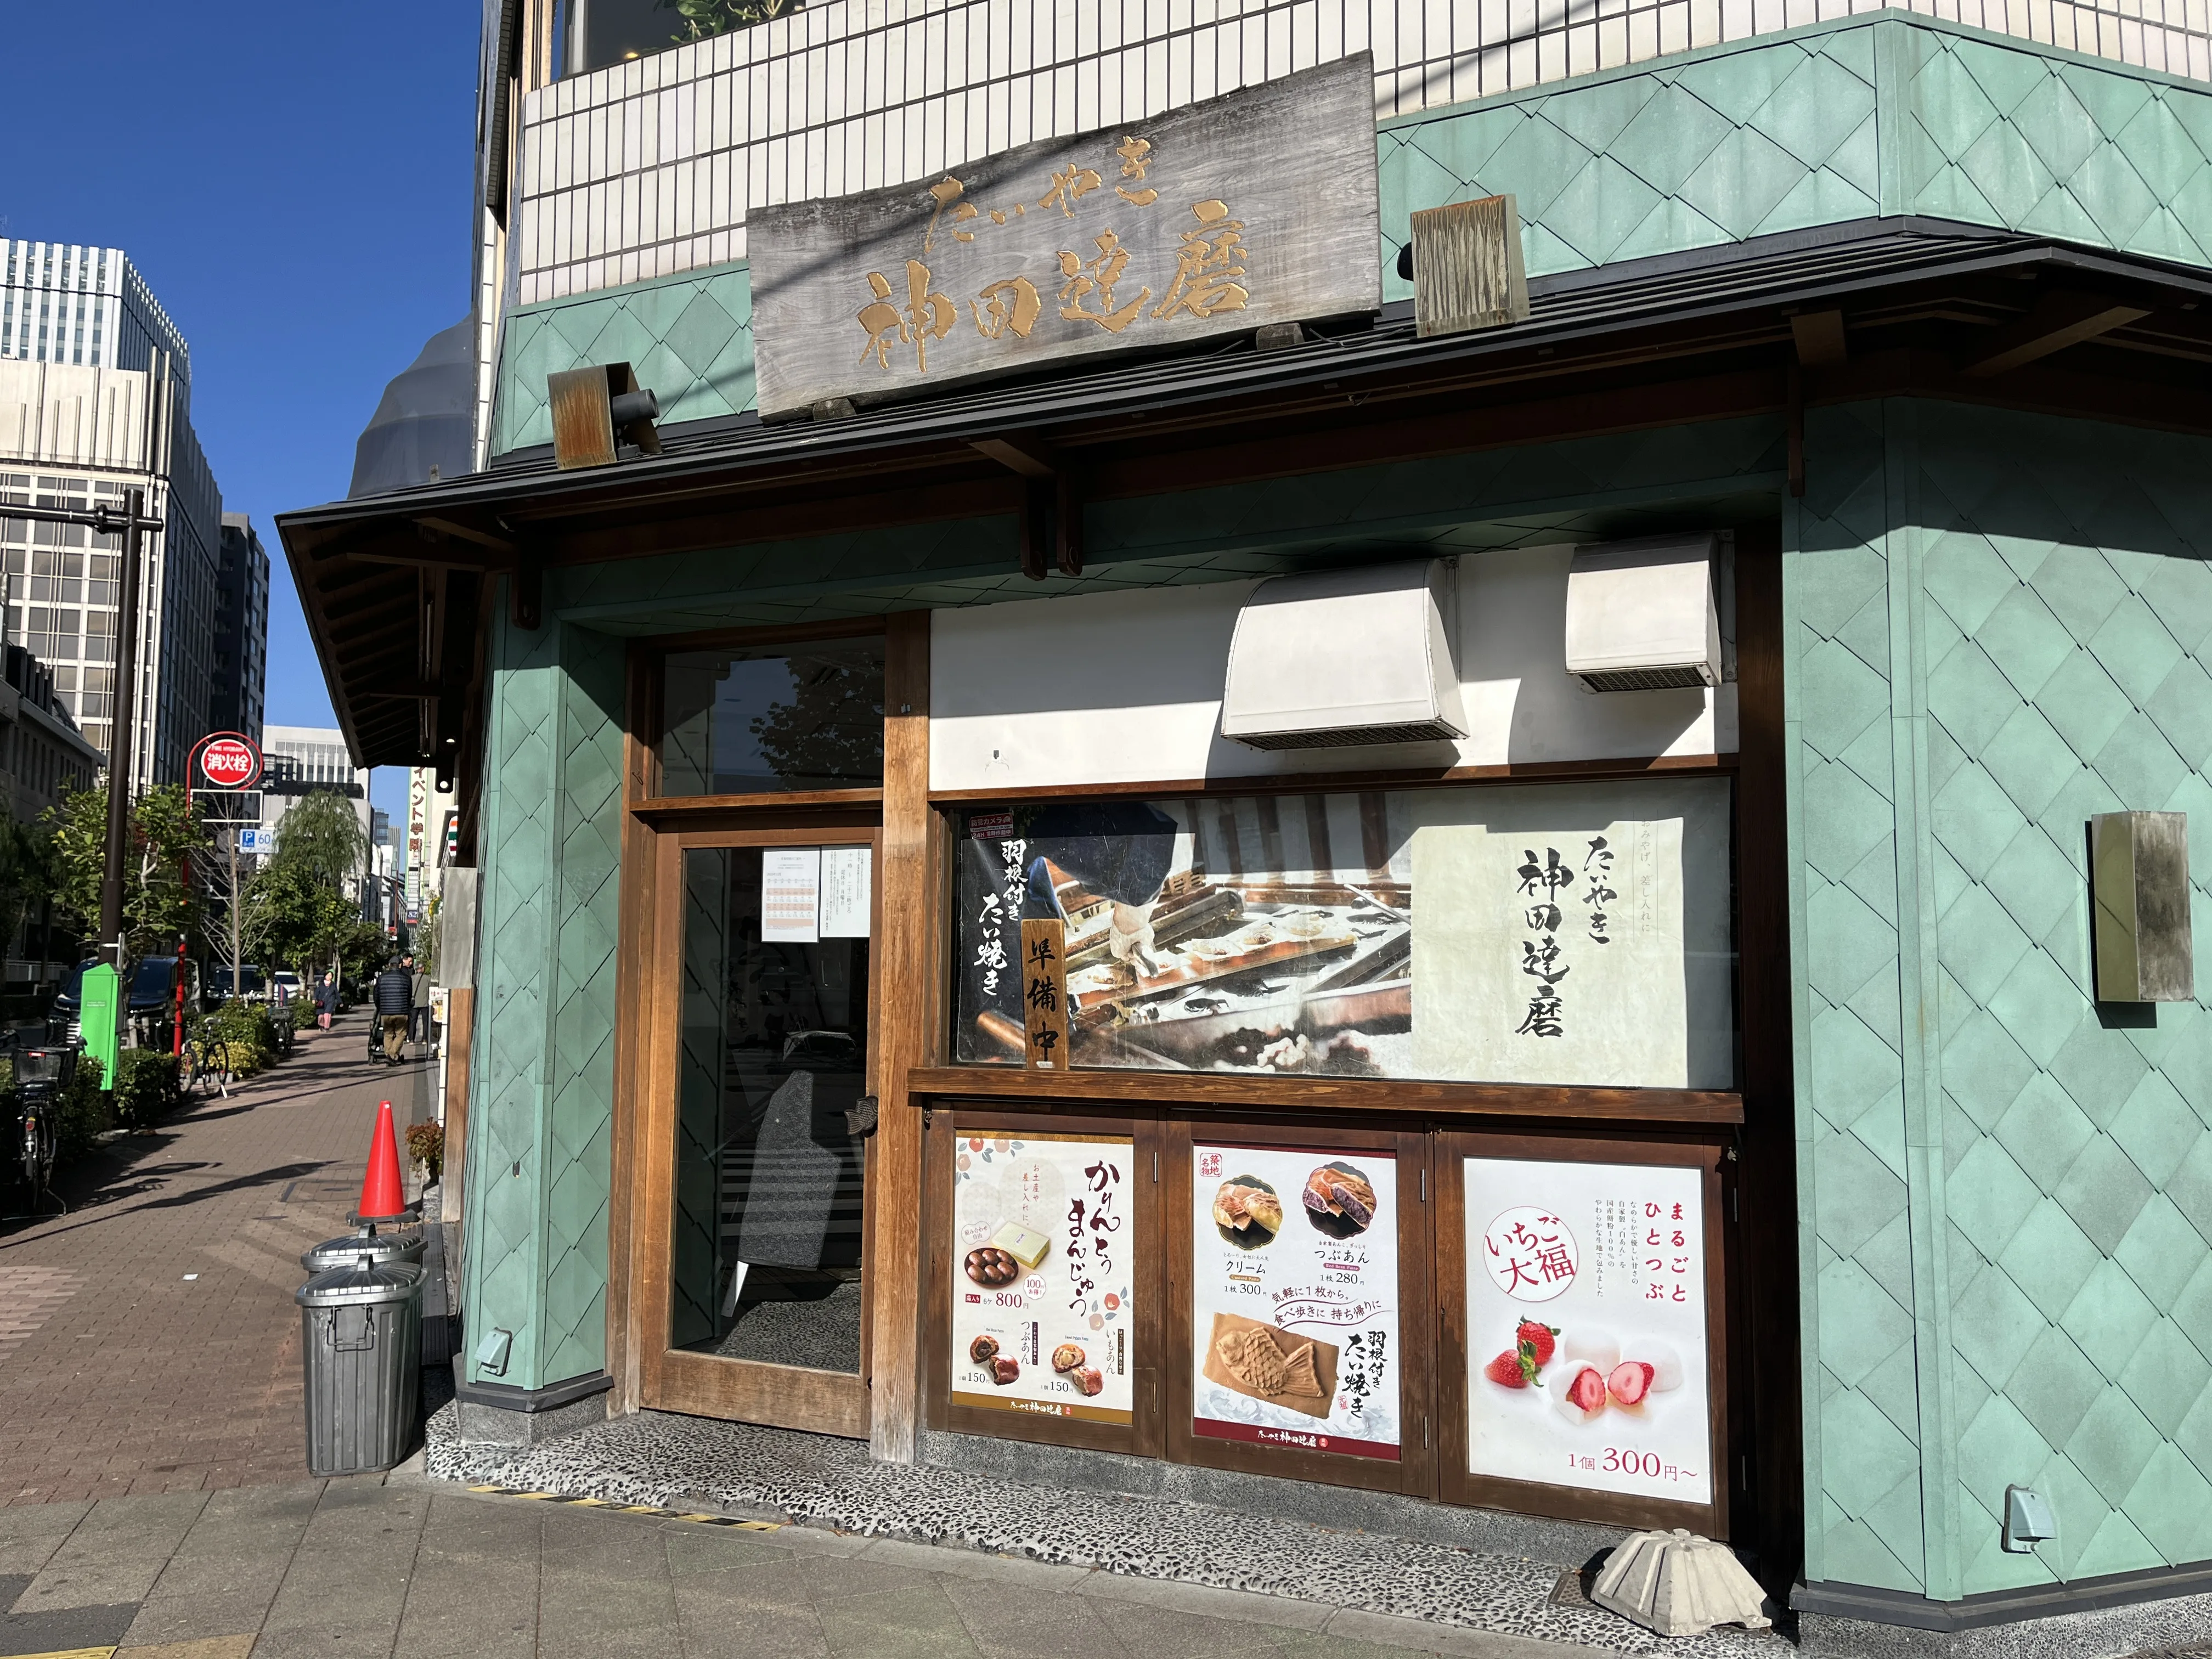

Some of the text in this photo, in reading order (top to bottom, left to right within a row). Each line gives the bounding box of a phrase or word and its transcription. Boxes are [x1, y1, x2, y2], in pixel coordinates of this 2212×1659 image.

[923, 136, 1160, 254] たいやき
[857, 200, 1250, 373] 神田達磨
[207, 753, 249, 772] 消火栓
[245, 832, 252, 842] P
[972, 816, 1002, 827] 防犯カメラ
[1000, 838, 1029, 922] 羽根付き
[1582, 836, 1617, 944] たいやき
[973, 893, 1008, 996] たい焼き
[1515, 847, 1575, 1037] 神田達磨
[1026, 938, 1059, 1061] 準備中
[1201, 1158, 1209, 1175] 名物
[964, 1226, 988, 1235] 組み合わせ
[1085, 1160, 1120, 1274] かりんとう
[1486, 1216, 1560, 1257] いちご
[1067, 1198, 1094, 1317] まんじゅう
[1314, 1249, 1370, 1263] つぶあん
[1595, 1199, 1604, 1297] やわらかな生地で包みました
[1630, 1201, 1639, 1284] なめらかで優しい甘さの
[1645, 1201, 1664, 1300] ひとつぶ
[1671, 1202, 1689, 1302] まるごと
[1226, 1260, 1266, 1274] クリーム
[1240, 1283, 1267, 1296] 300円
[1336, 1273, 1364, 1285] 280円
[1500, 1243, 1575, 1294] 大福
[996, 1292, 1029, 1309] 800円
[1272, 1285, 1348, 1304] 気軽に1枚から。
[1274, 1300, 1382, 1326] 食べ歩きに 持ち帰りに
[1020, 1321, 1030, 1365] つぶあん
[1106, 1329, 1115, 1374] いもあん
[1367, 1330, 1388, 1389] 羽根付き
[1342, 1333, 1371, 1418] たい焼き
[1568, 1454, 1595, 1471] 1個
